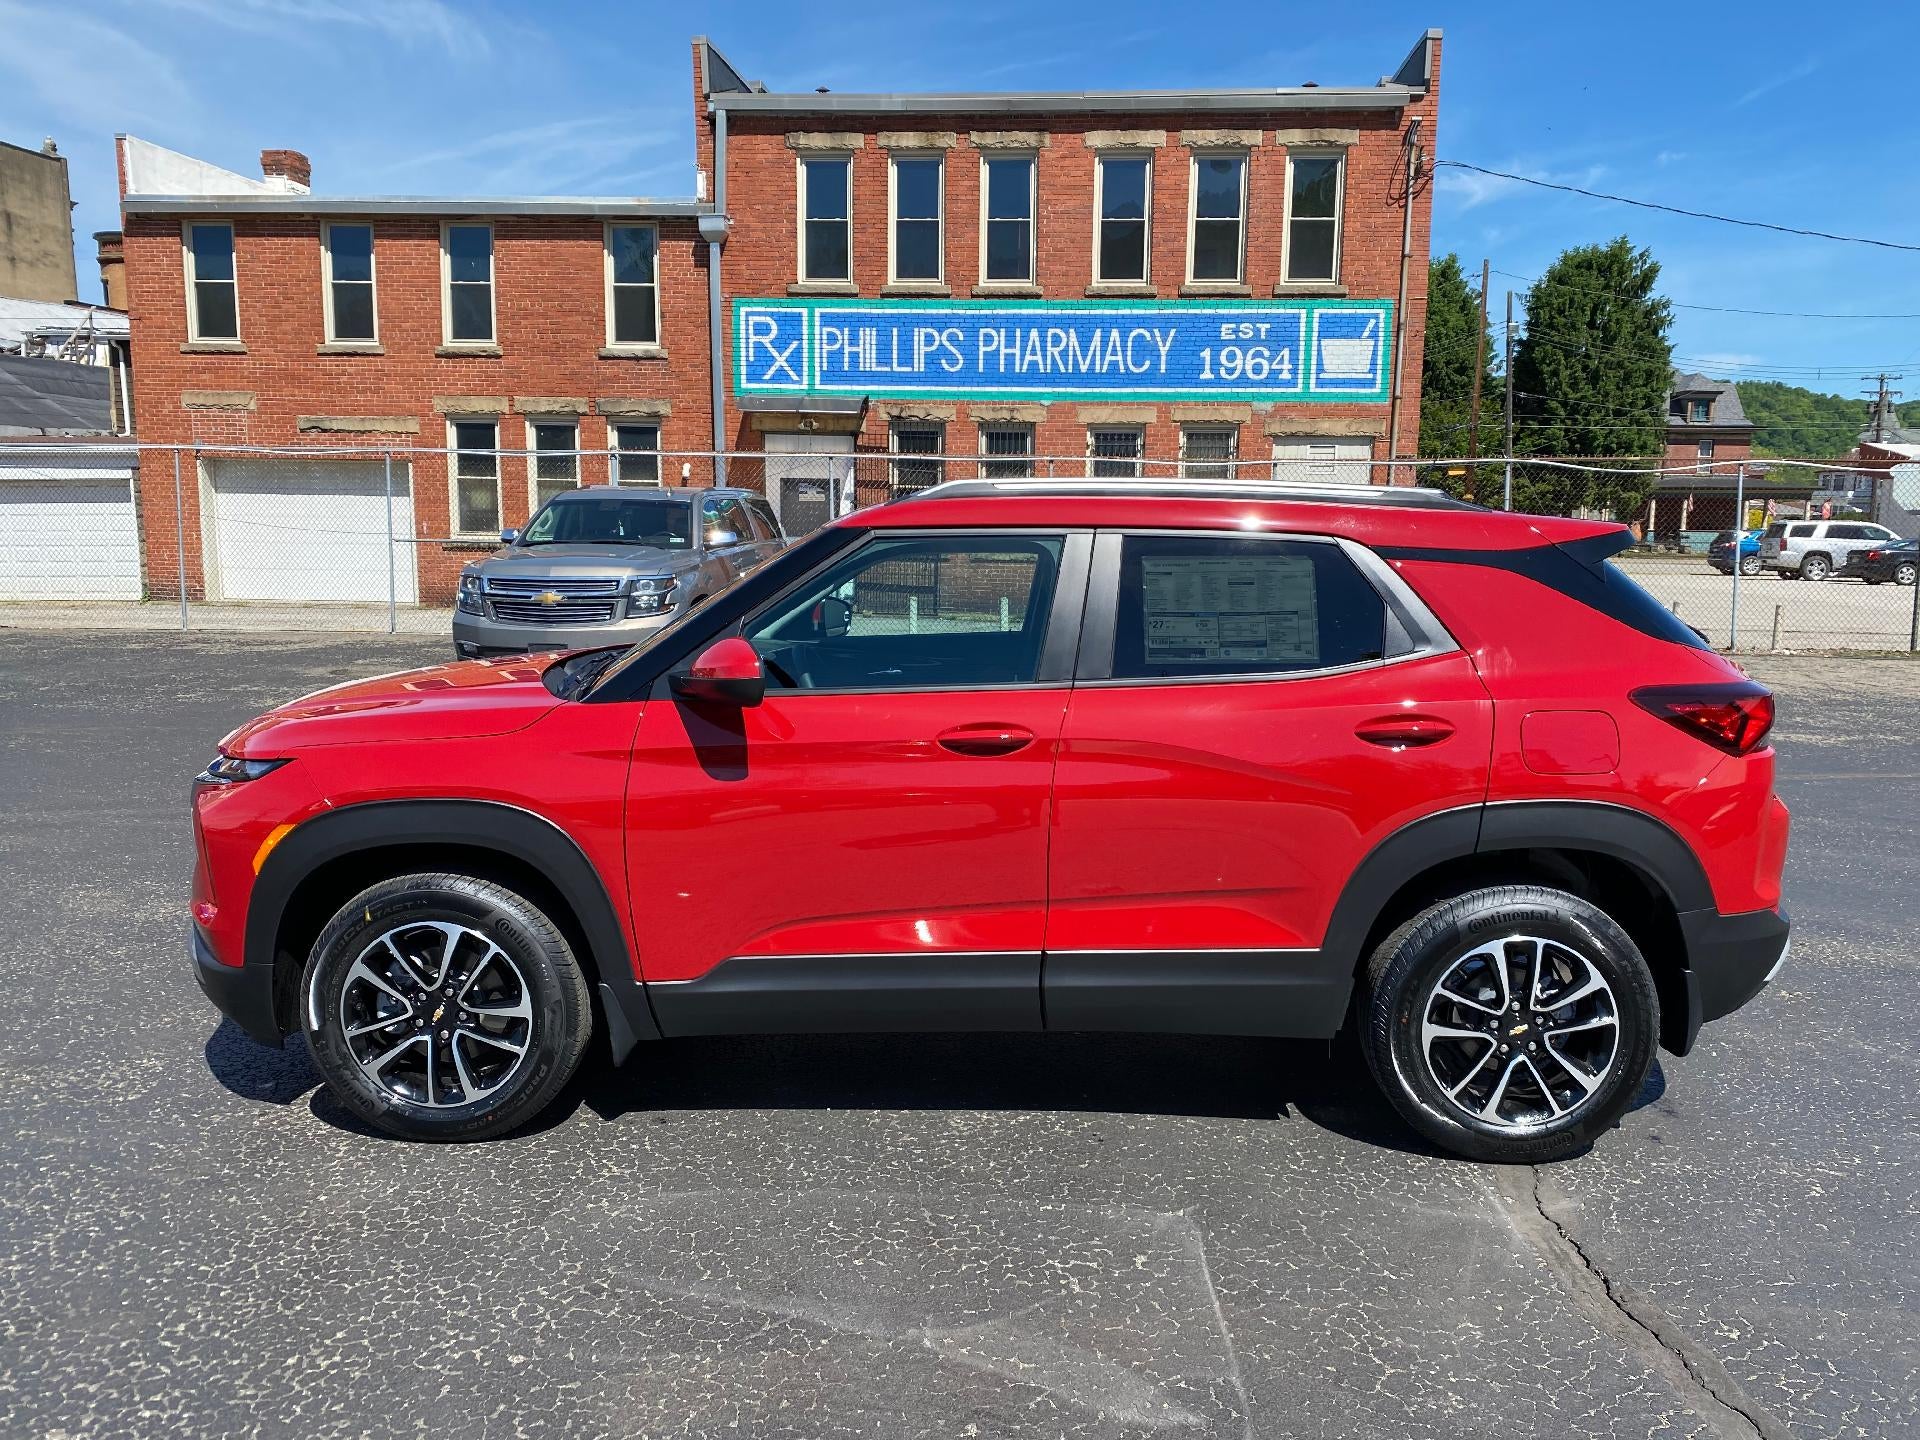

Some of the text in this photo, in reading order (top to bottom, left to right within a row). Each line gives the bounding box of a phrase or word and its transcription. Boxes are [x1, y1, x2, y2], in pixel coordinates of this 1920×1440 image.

[1220, 323, 1271, 340] EST
[822, 327, 1177, 374] PHILLIPS PHARMACY
[1199, 346, 1293, 380] 1964
[1467, 909, 1549, 933] Continental
